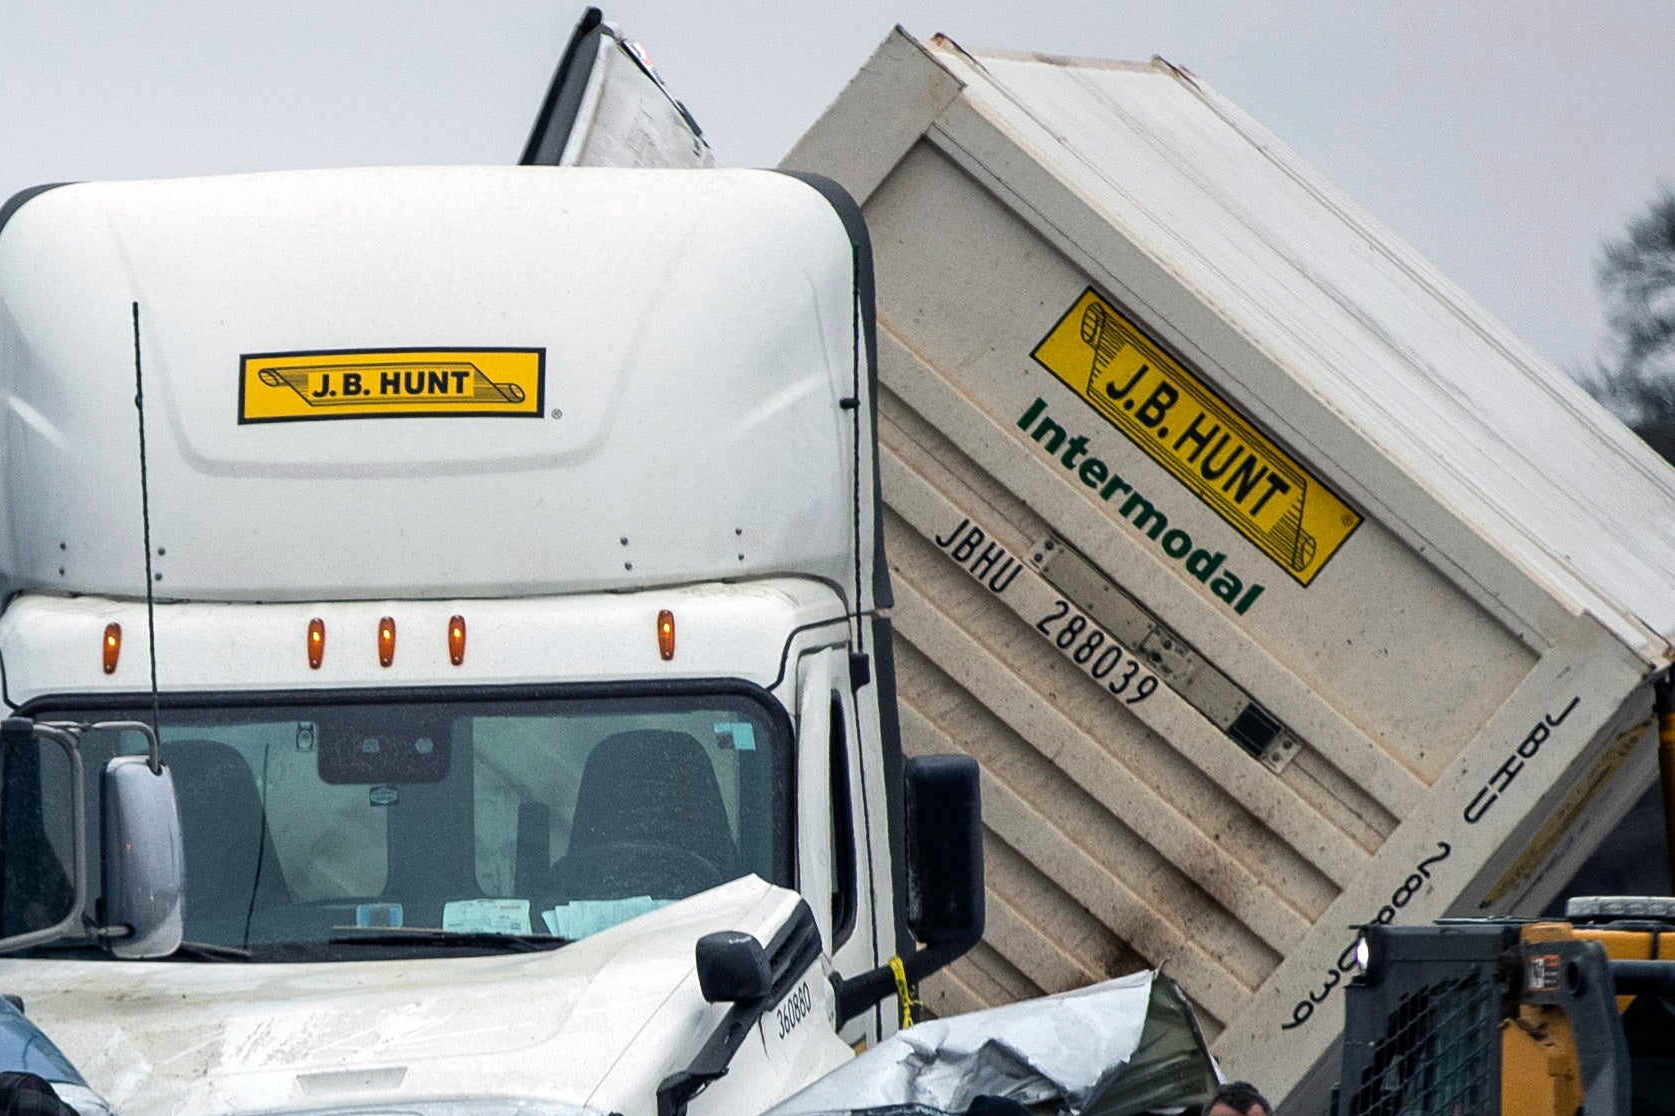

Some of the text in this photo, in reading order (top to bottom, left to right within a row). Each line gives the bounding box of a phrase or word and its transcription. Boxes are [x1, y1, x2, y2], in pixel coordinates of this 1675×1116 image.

[380, 370, 470, 395] HUNT
[1016, 397, 1266, 616] Intermodal
[1172, 412, 1291, 517] HUNT
[935, 518, 1159, 704] JBHU 288039
[1463, 696, 1581, 823] JBHU
[776, 981, 812, 1040] 360880
